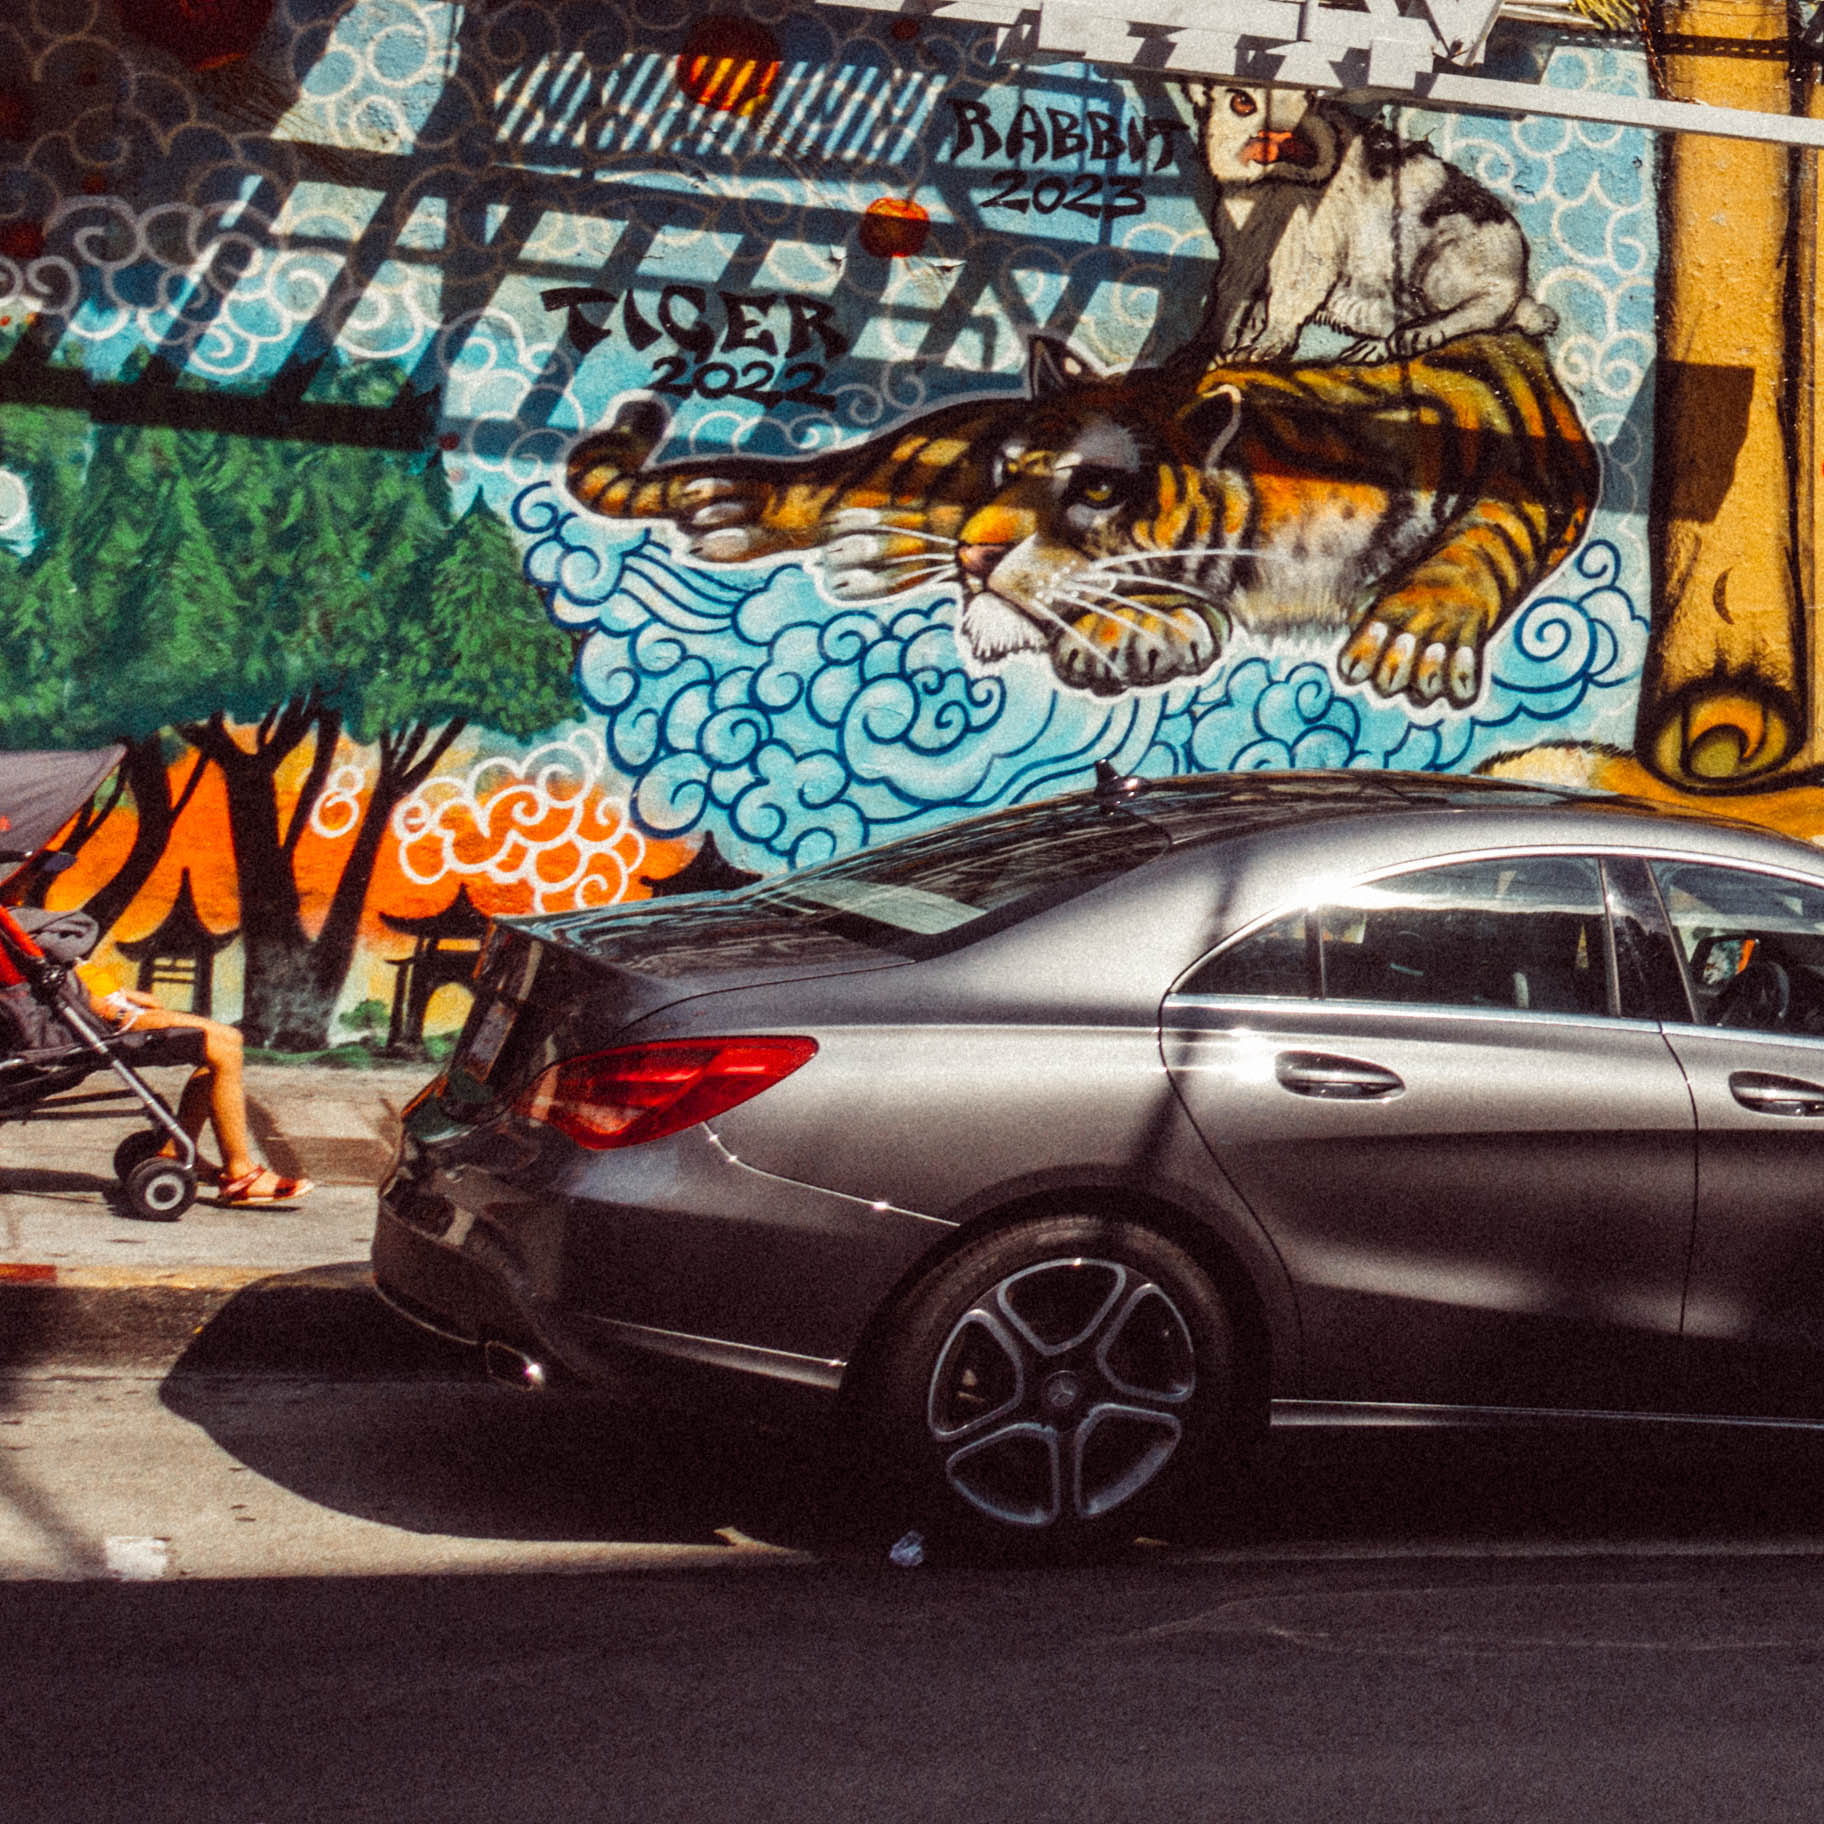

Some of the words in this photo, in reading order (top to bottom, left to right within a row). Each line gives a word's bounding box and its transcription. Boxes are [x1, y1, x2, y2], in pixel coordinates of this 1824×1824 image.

[947, 98, 1199, 171] RABBIT
[981, 171, 1146, 219] 2023
[541, 285, 850, 360] TIGER
[649, 356, 837, 411] 2022
